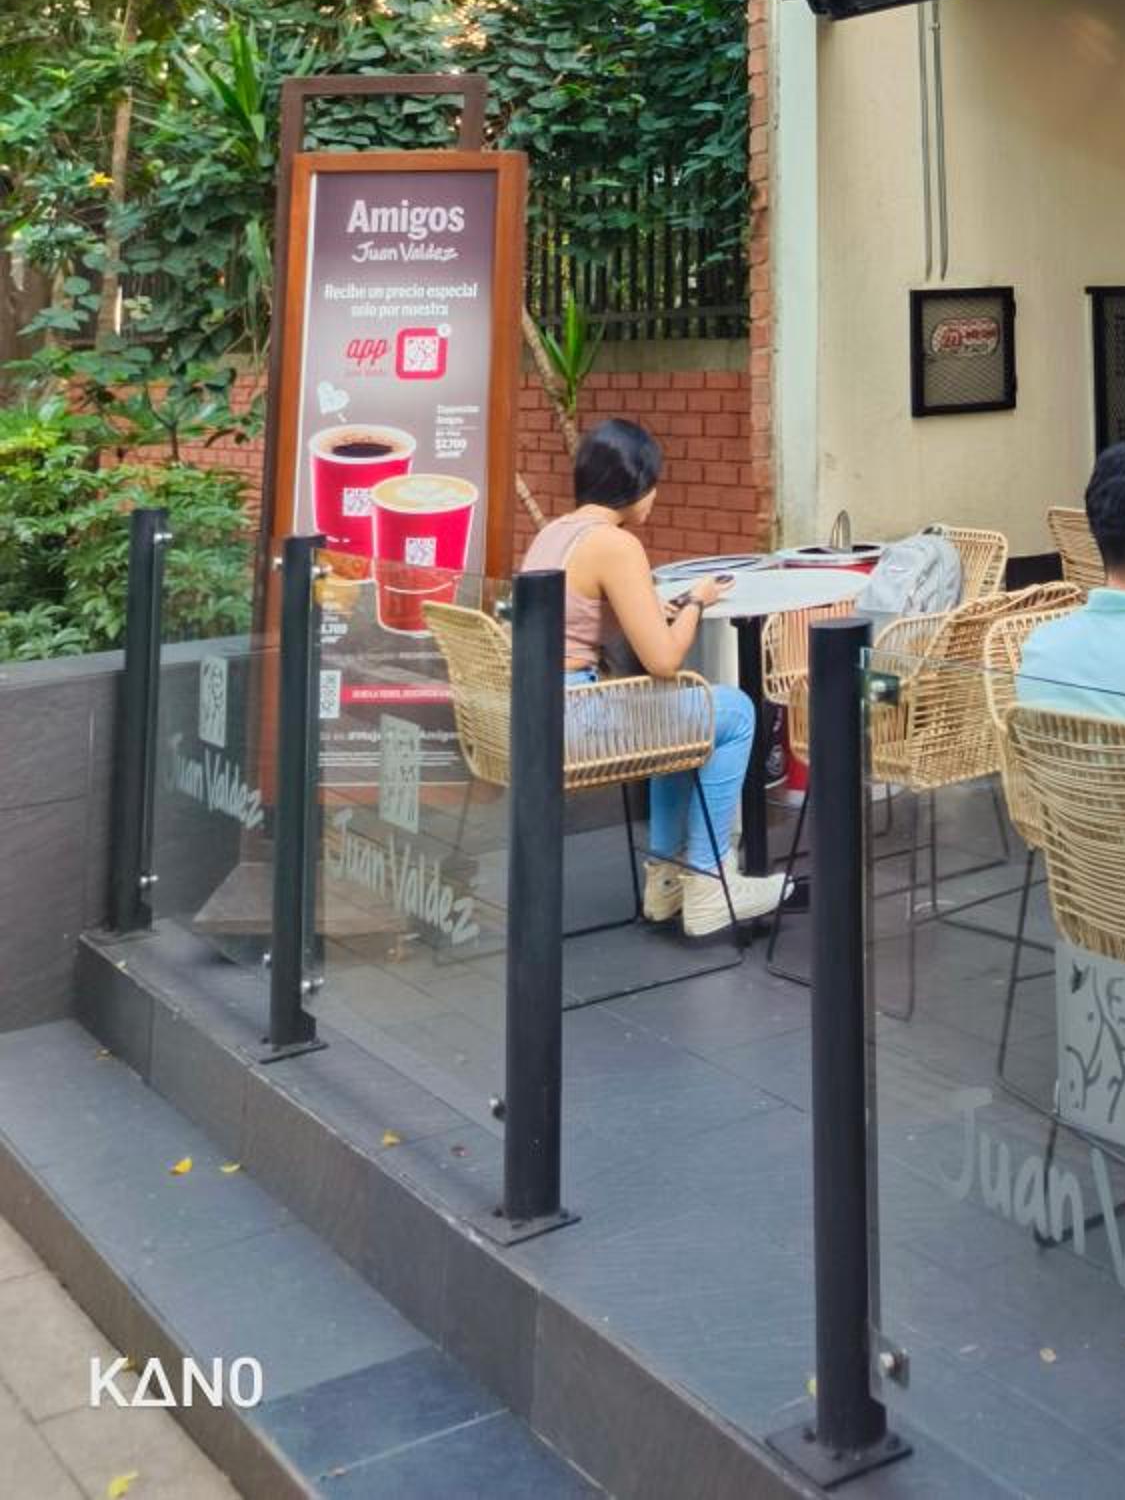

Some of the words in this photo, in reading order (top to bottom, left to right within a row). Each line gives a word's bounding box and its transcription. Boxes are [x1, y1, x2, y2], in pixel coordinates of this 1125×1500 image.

[347, 199, 465, 240] Amigos
[352, 242, 397, 263] Juan
[399, 243, 460, 263] Valdez
[346, 338, 391, 367] app
[388, 831, 480, 945] Valdez
[930, 1088, 1086, 1255] Juan
